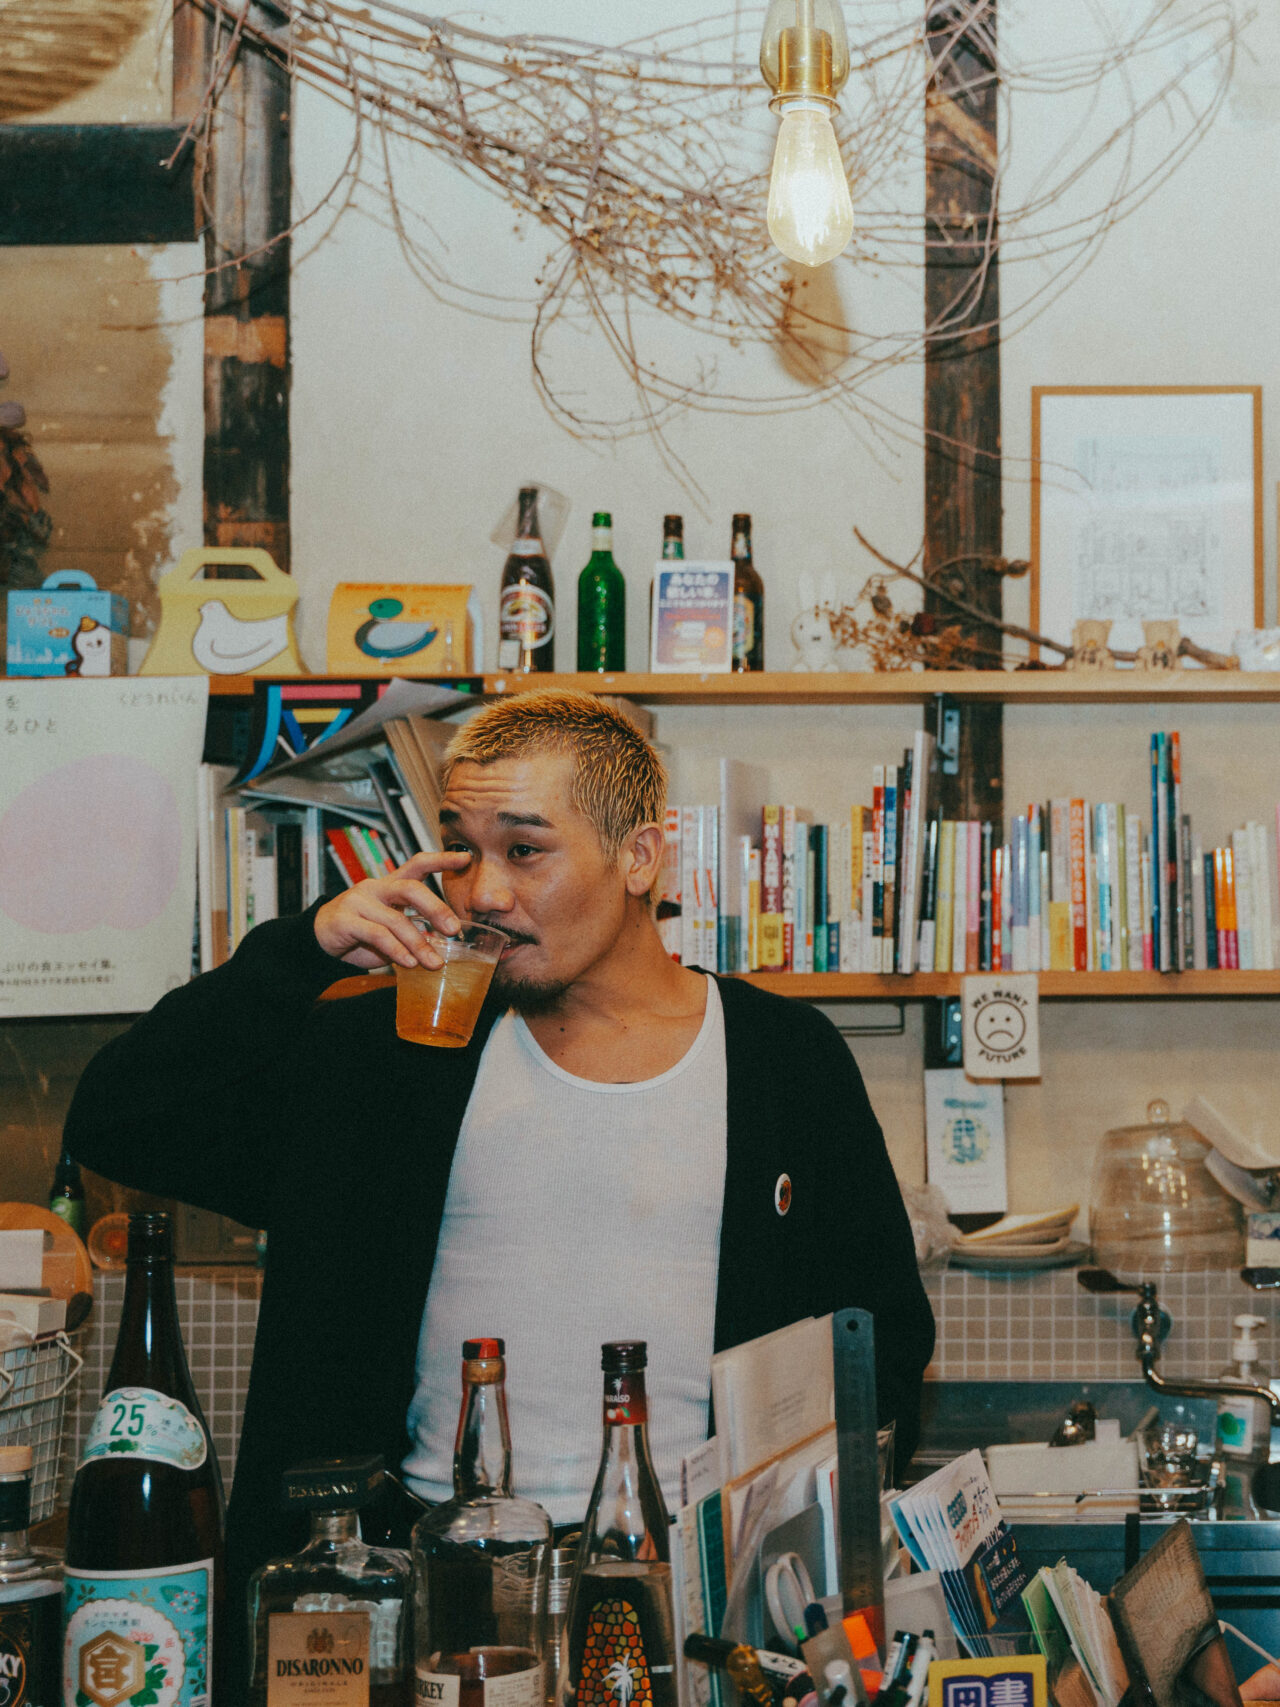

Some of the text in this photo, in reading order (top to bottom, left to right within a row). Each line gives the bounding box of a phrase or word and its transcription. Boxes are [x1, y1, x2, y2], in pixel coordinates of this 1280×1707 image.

[971, 990, 1029, 1009] WE WANT
[978, 1046, 1027, 1064] FUTURE
[276, 1658, 364, 1678] DISARONNO
